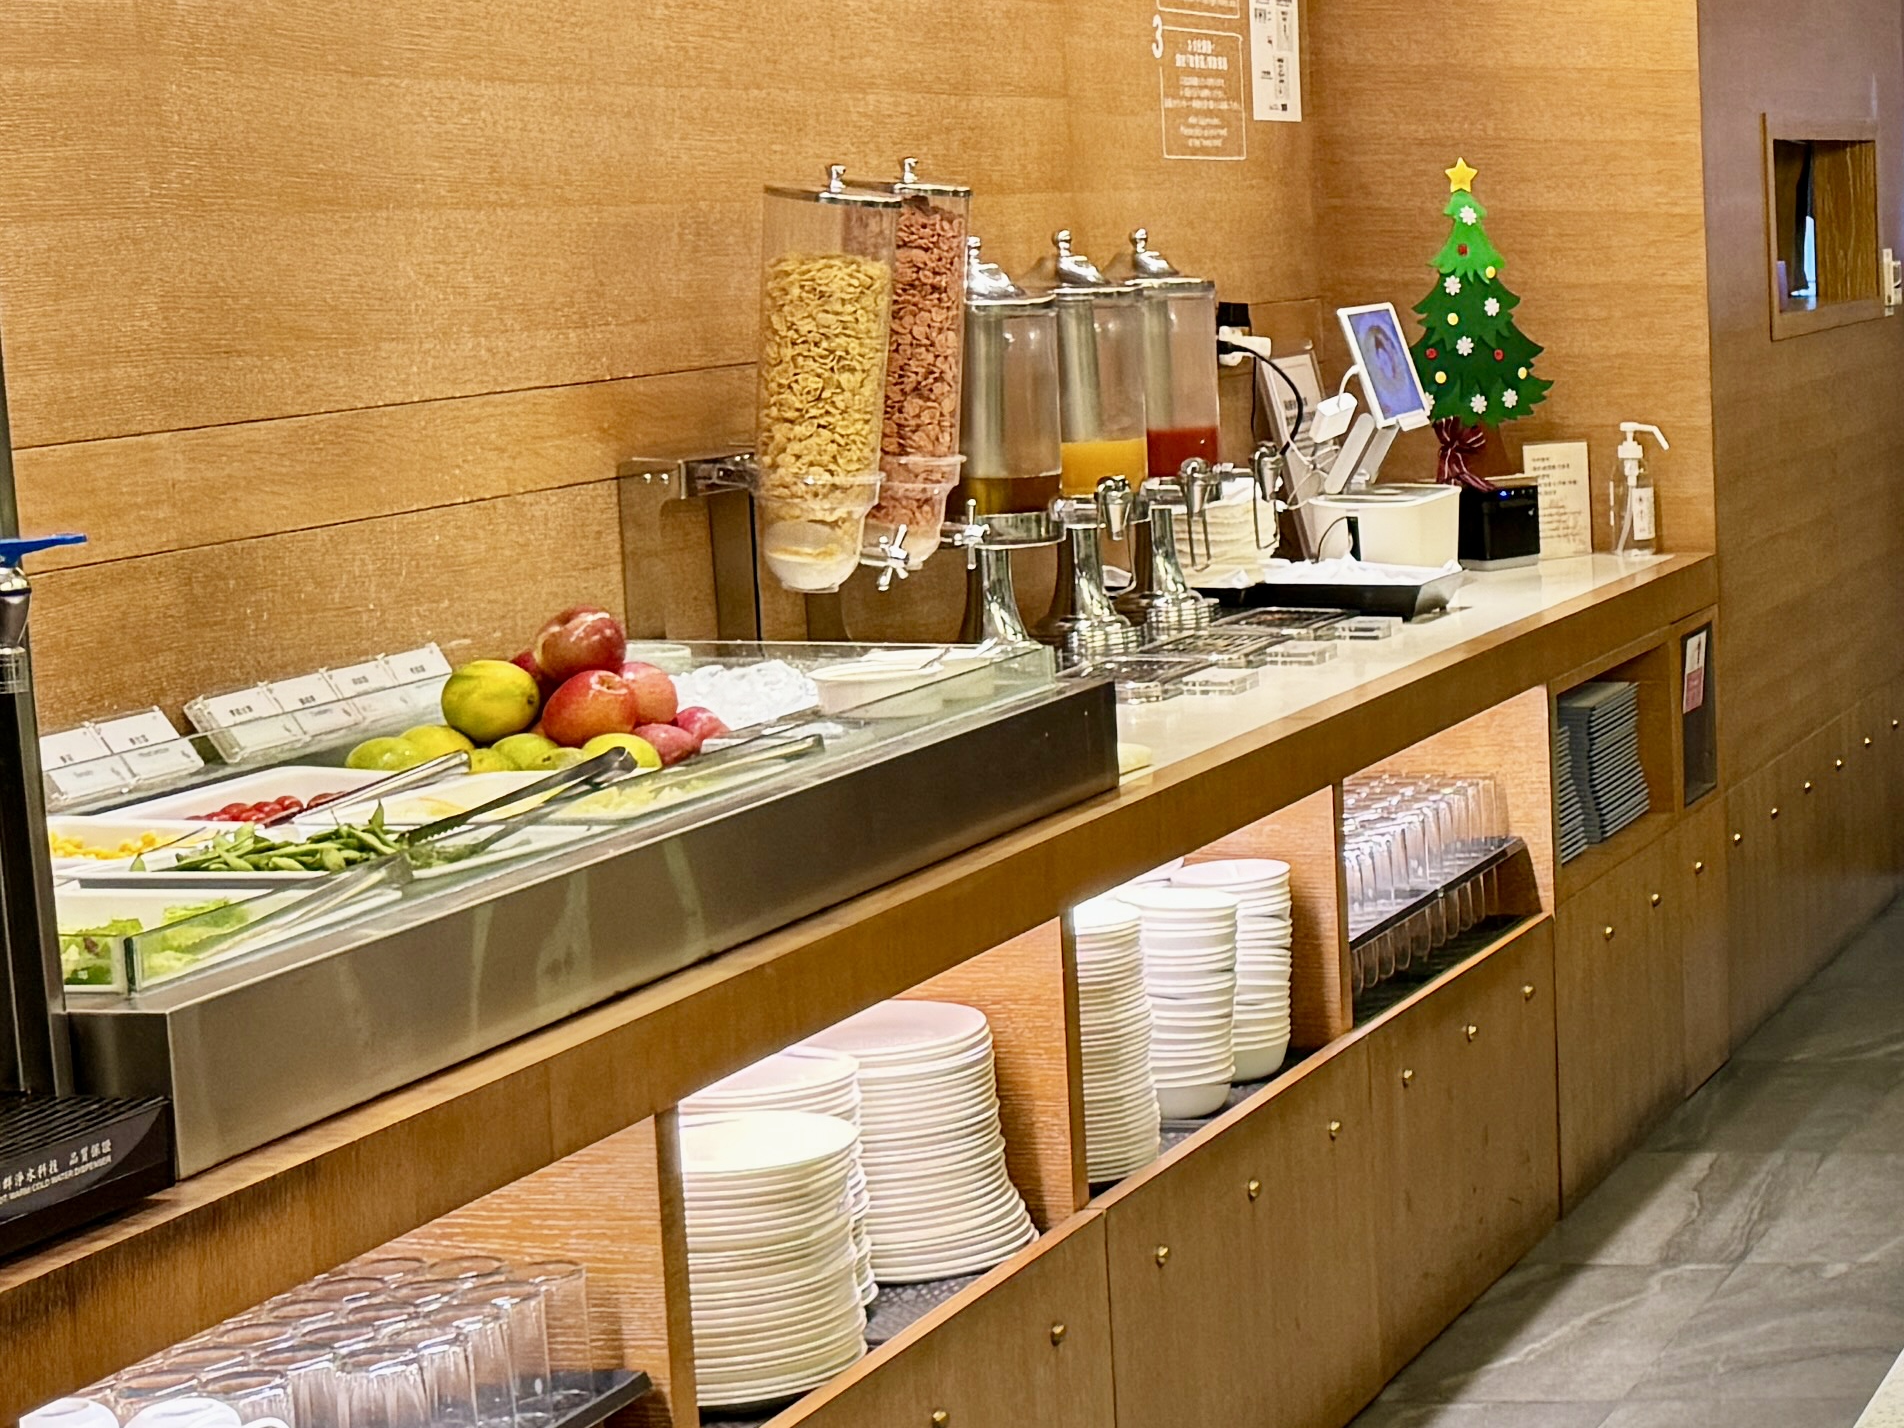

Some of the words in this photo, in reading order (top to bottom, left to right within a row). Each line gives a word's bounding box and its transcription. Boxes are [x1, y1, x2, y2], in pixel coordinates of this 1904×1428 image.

[1152, 14, 1164, 59] 3
[32, 1178, 51, 1192] COLD
[51, 1169, 74, 1184] WATER
[74, 1154, 112, 1176] DISPENSER
